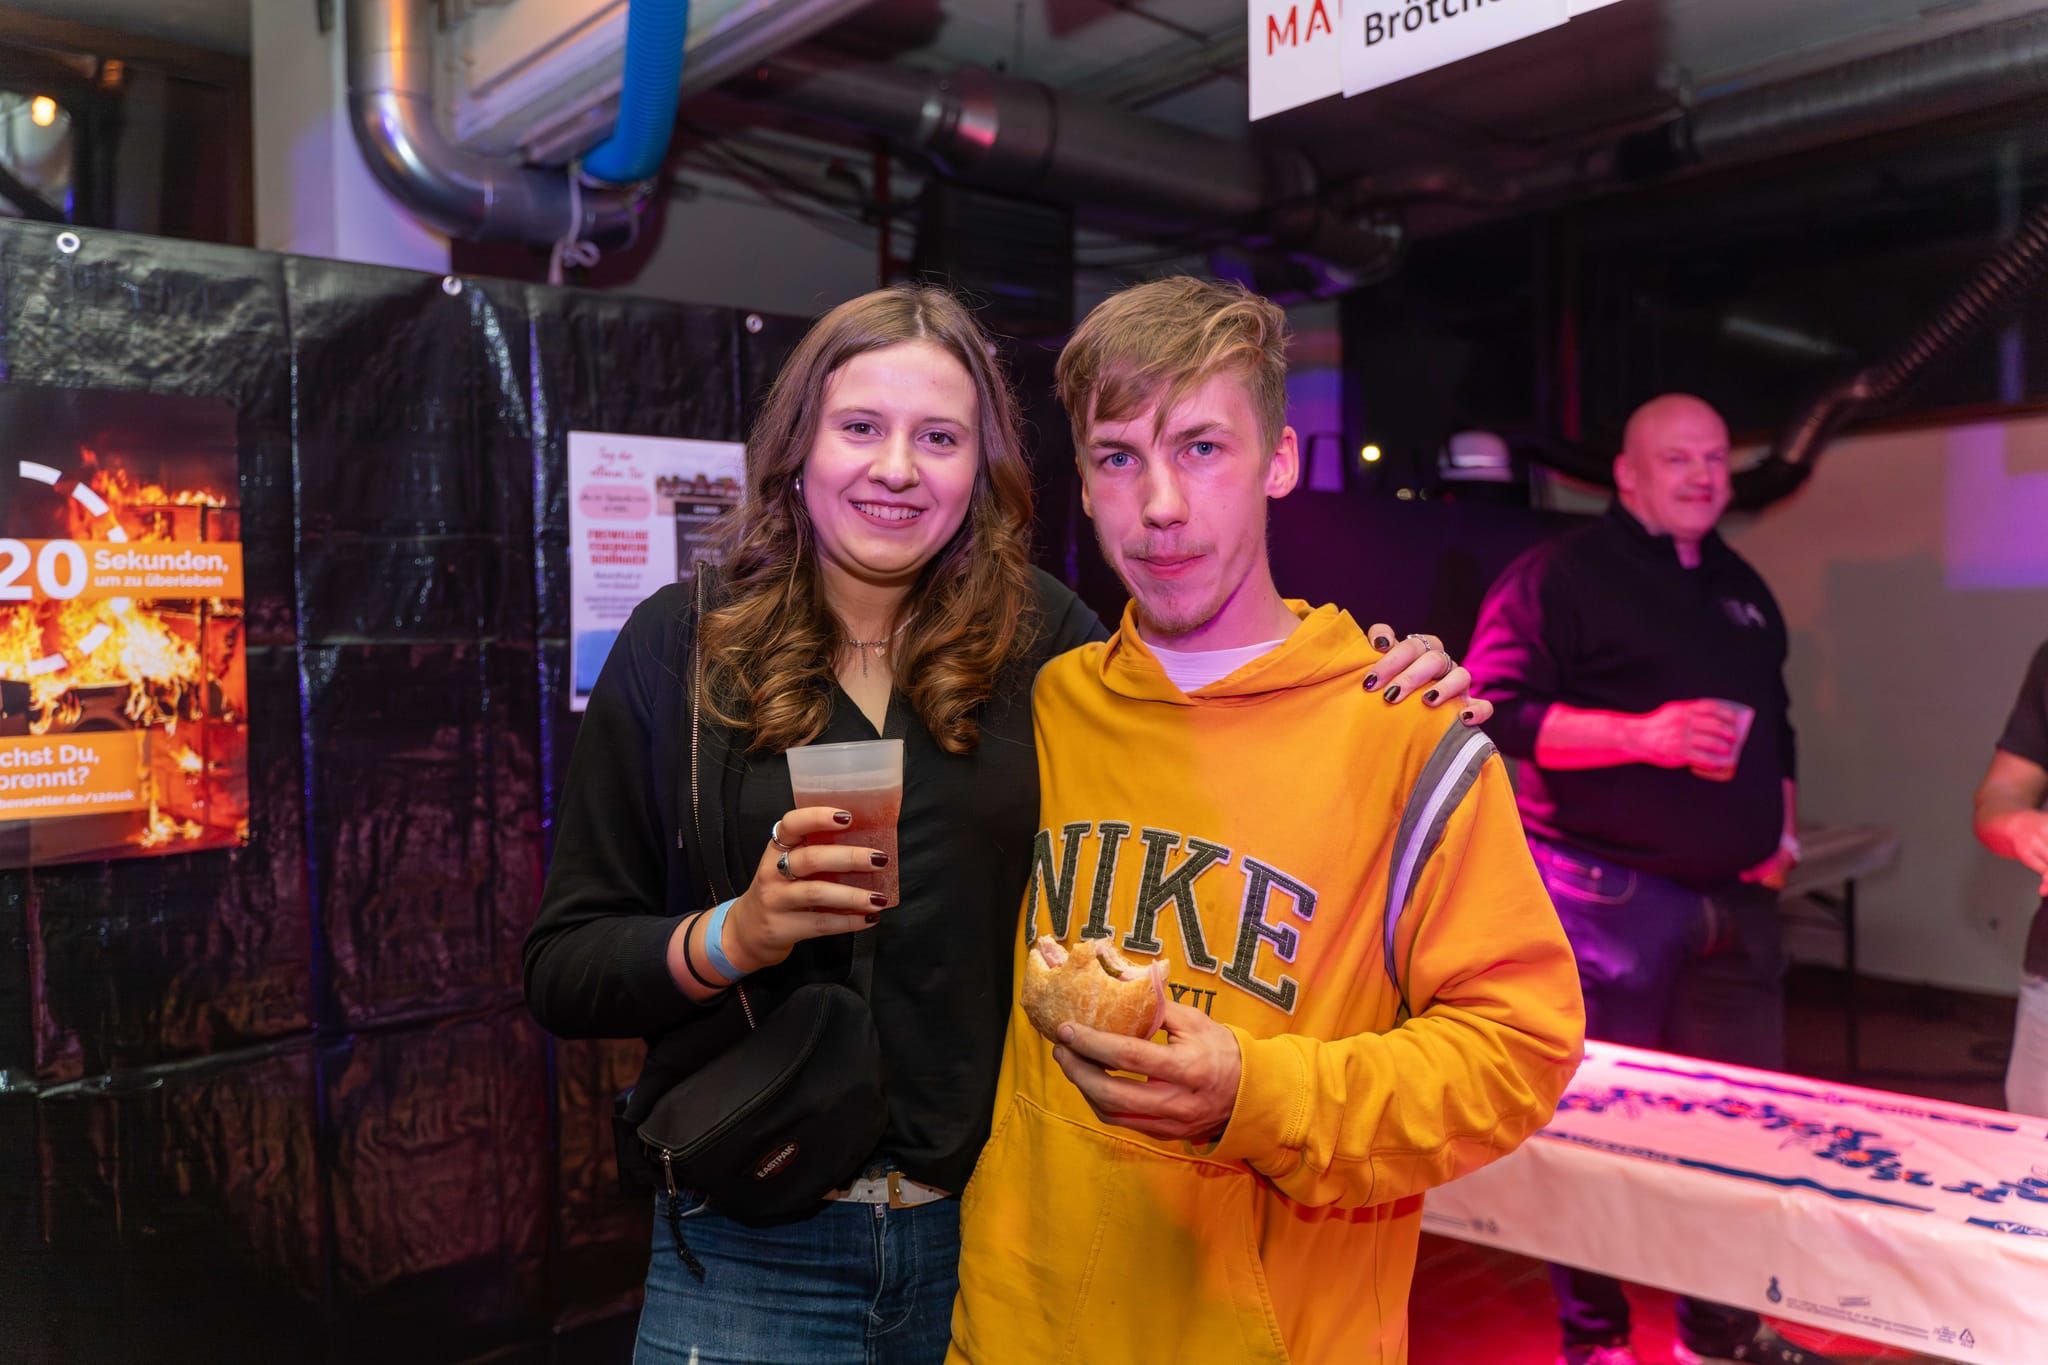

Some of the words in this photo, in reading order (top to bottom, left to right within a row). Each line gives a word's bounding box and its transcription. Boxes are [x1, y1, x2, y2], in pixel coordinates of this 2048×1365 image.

[1266, 0, 1342, 56] MA
[1364, 0, 1502, 47] Brötc
[94, 550, 229, 572] Sekunden,
[94, 575, 121, 587] um
[123, 575, 142, 587] zu
[144, 573, 224, 587] überleben
[59, 744, 100, 765] Du,
[1025, 820, 1318, 1016] NIKE
[757, 1143, 796, 1178] EASTPAK
